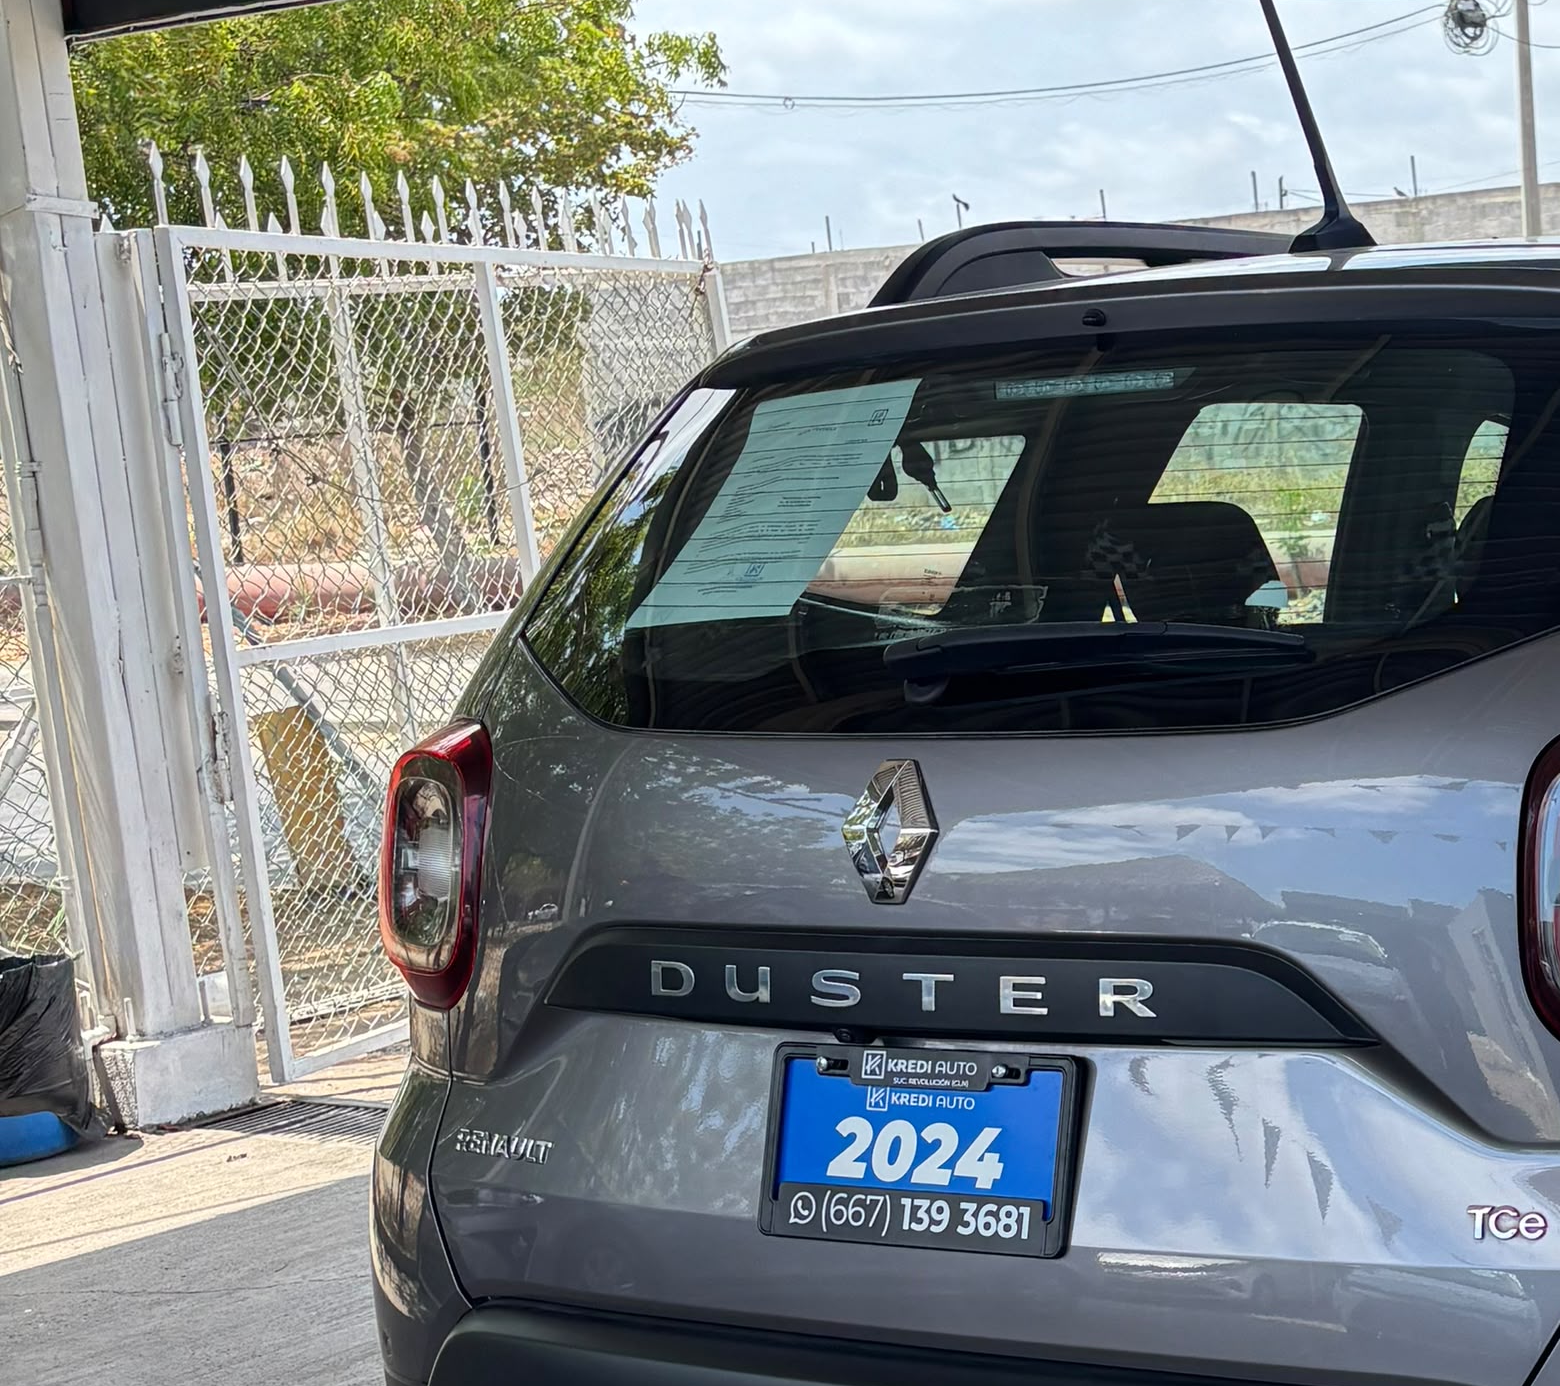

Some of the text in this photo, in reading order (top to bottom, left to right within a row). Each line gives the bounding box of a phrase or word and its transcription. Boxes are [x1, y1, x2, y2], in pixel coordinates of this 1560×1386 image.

[650, 959, 1157, 1018] DUSTER
[887, 1059, 932, 1073] KREDI
[935, 1061, 977, 1076] AUTO
[891, 1092, 933, 1107] KREDI
[936, 1095, 975, 1110] AUTO
[455, 1128, 552, 1164] RENAULT
[826, 1116, 1004, 1189] 2024
[821, 1190, 1031, 1240] (667) 139 3681
[1467, 1205, 1548, 1241] TCe
